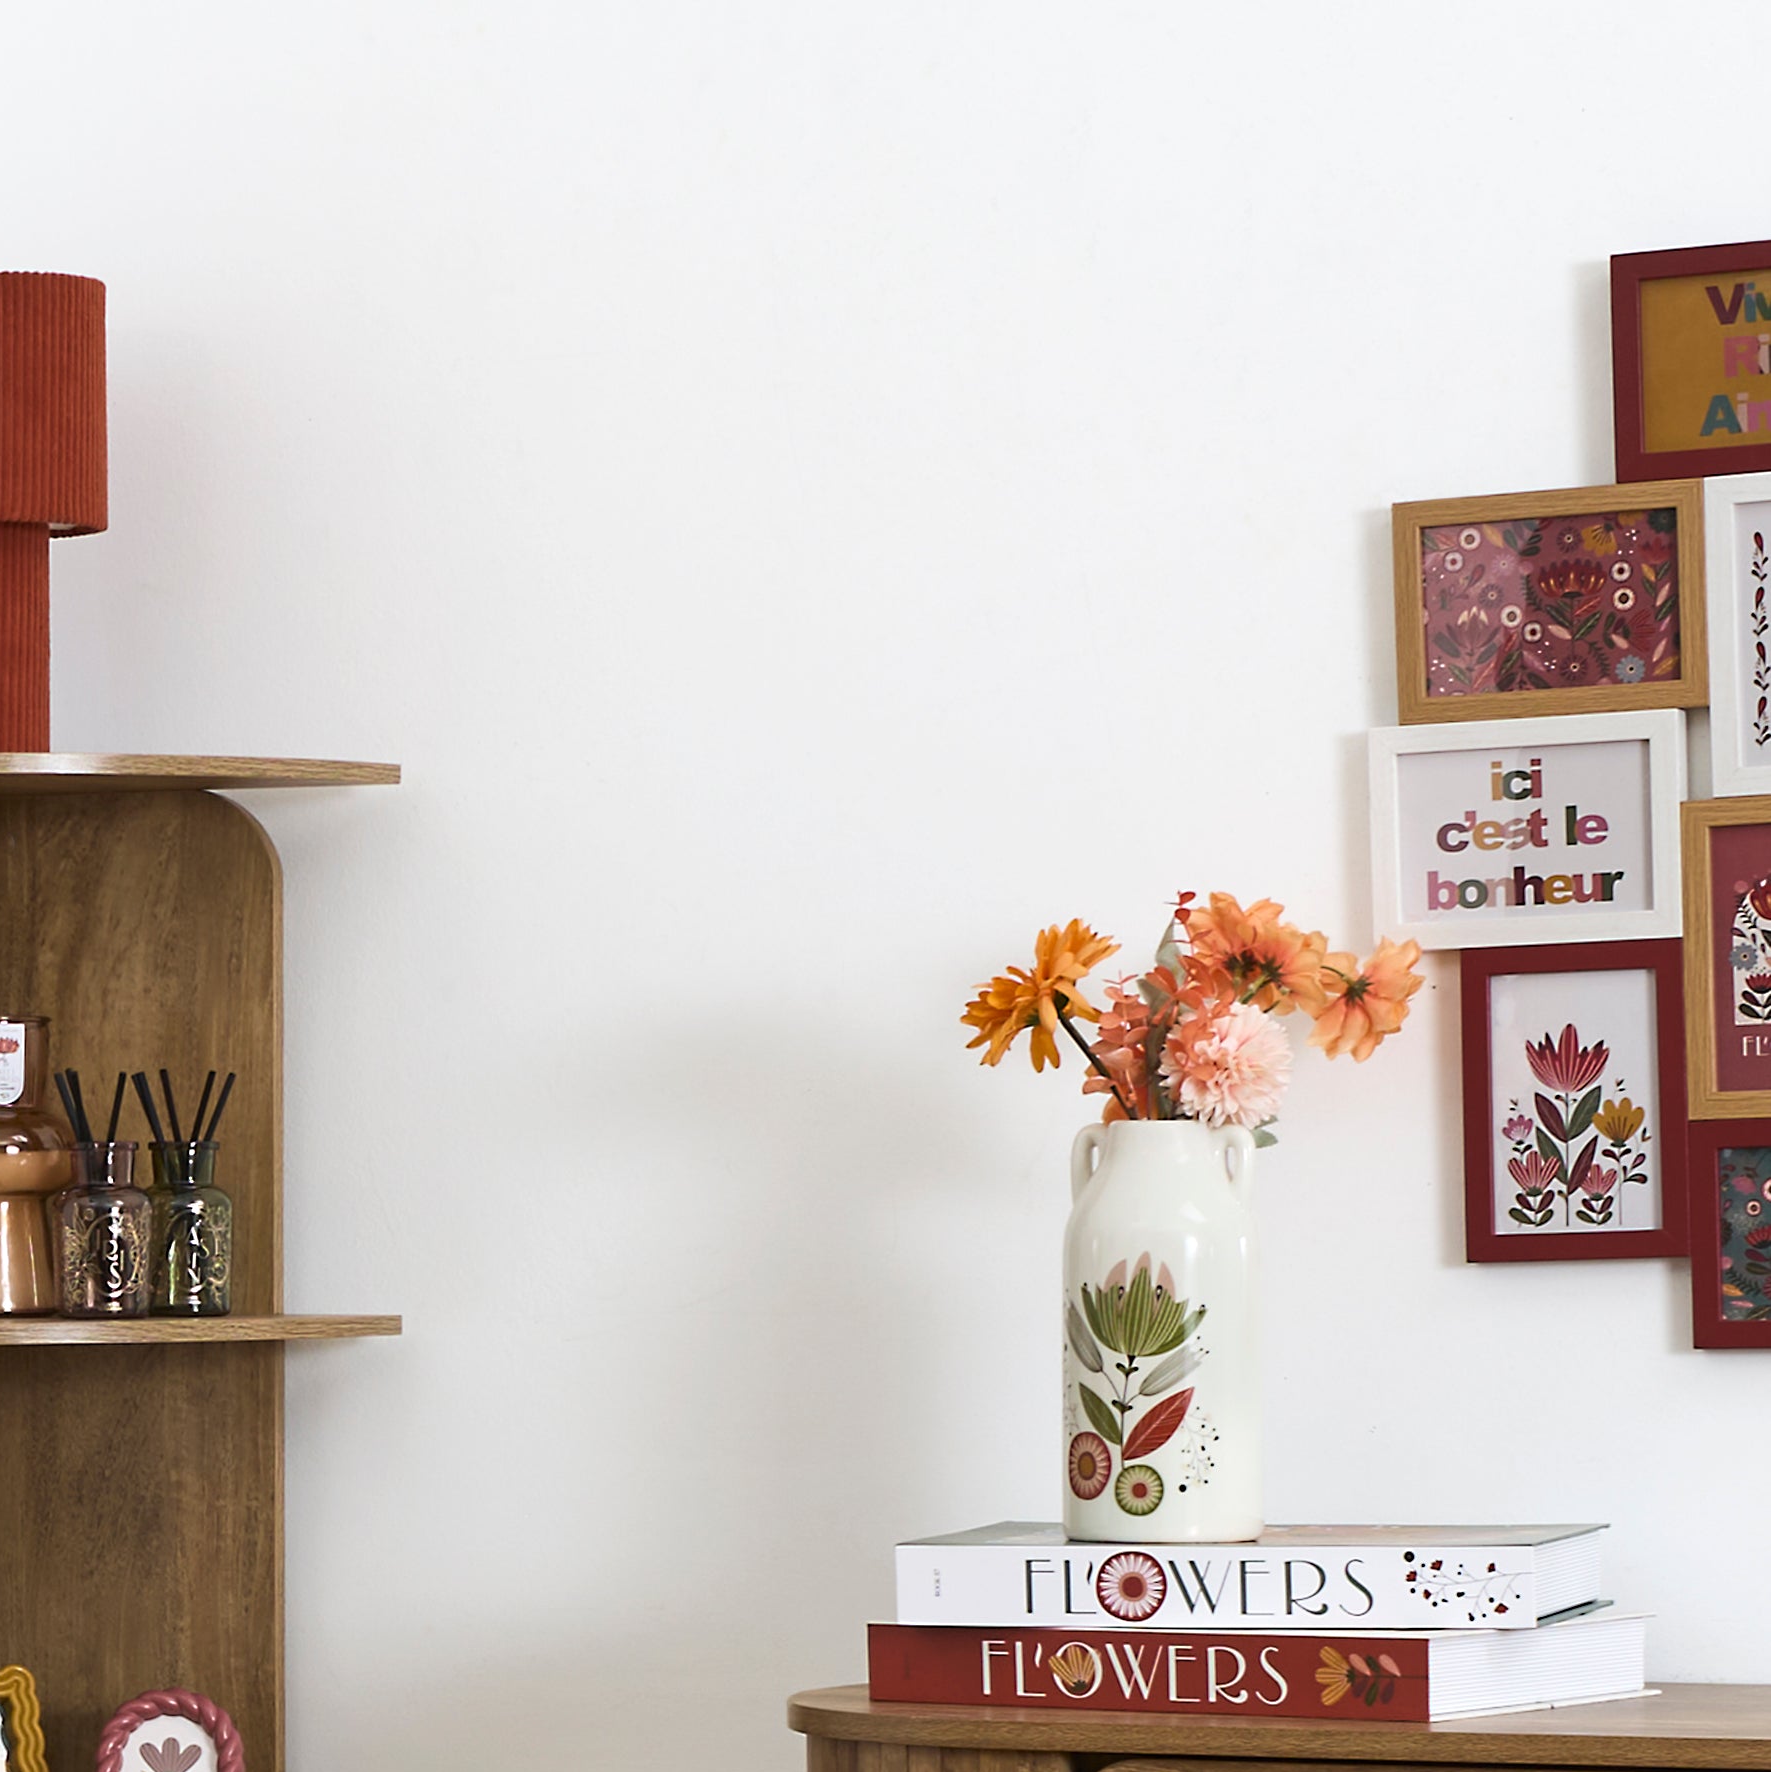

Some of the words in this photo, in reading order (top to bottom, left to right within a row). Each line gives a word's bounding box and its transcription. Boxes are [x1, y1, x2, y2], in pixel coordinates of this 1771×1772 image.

[1491, 758, 1543, 801] ici
[1436, 808, 1549, 852] c'est
[1565, 805, 1609, 846] le
[1427, 866, 1624, 910] bonheur
